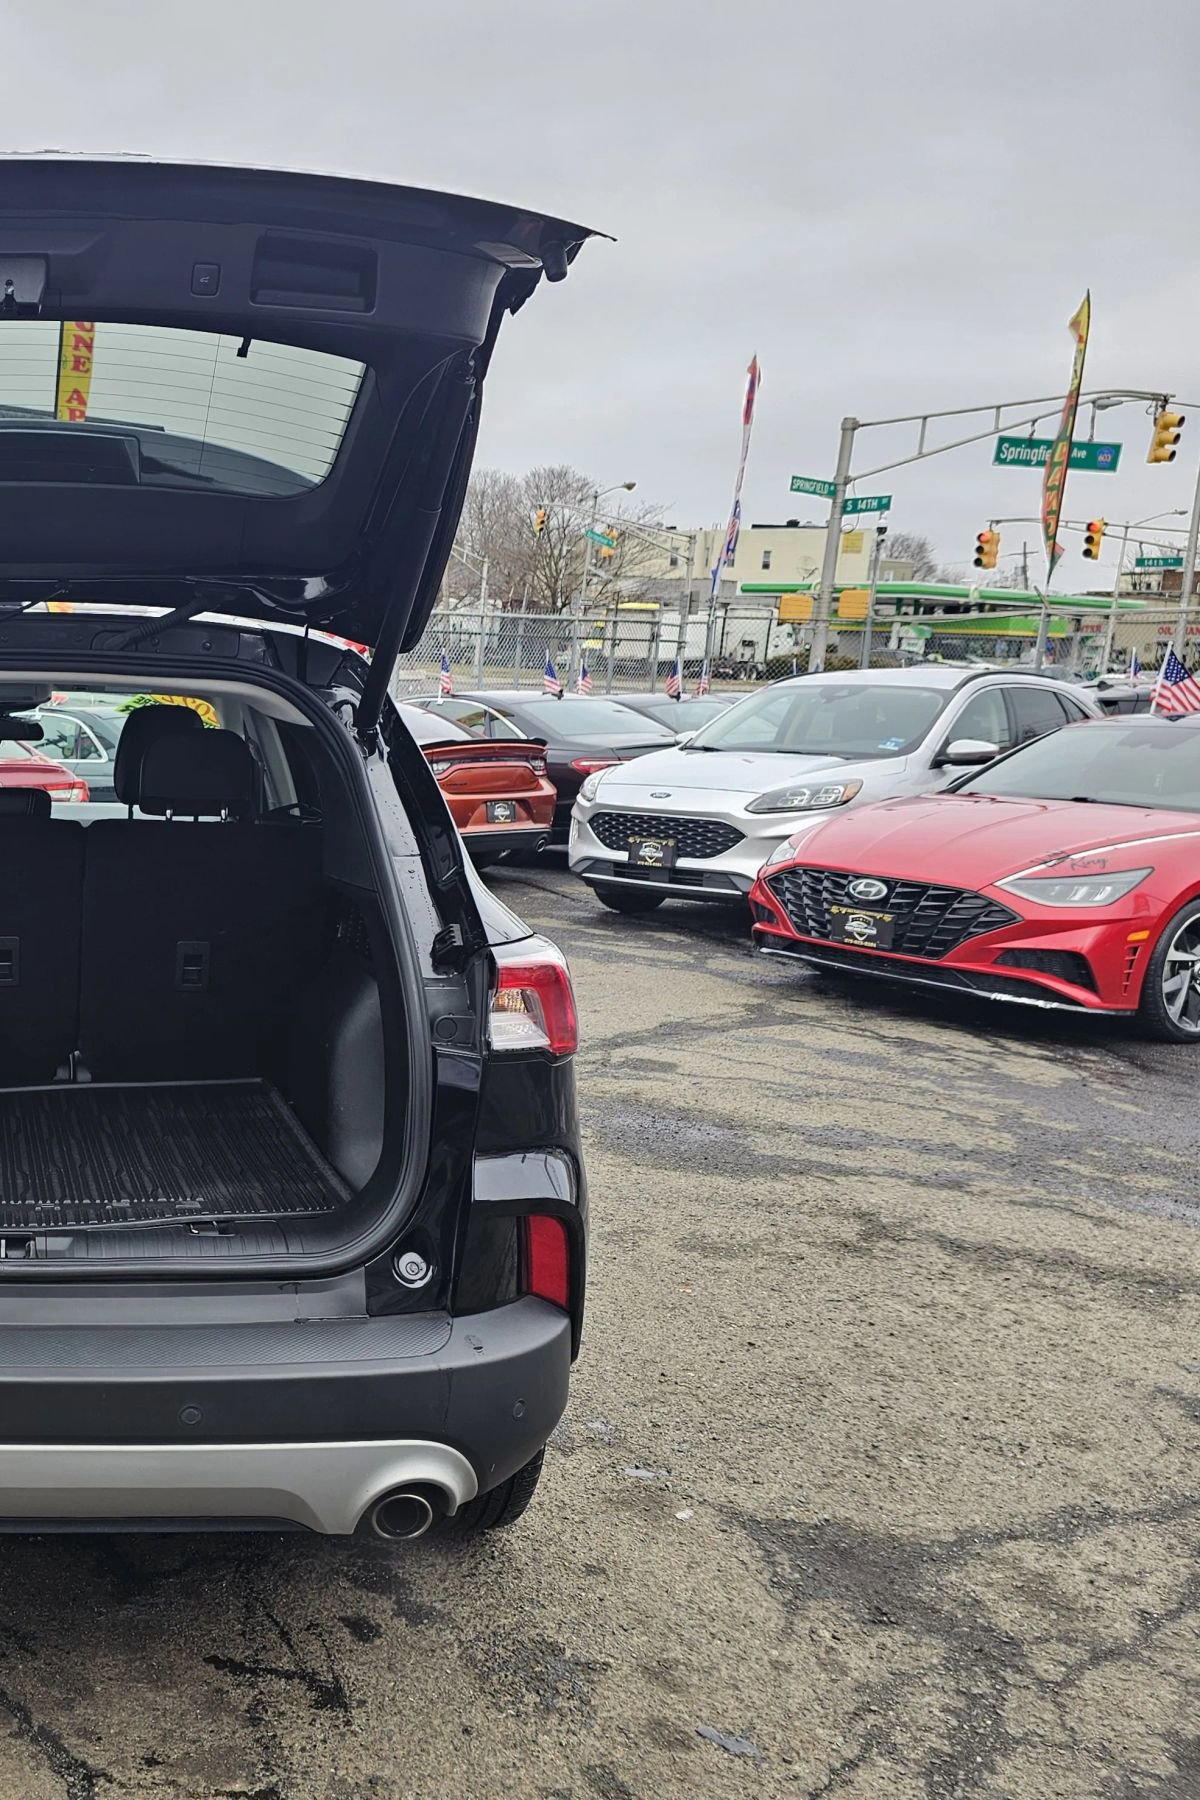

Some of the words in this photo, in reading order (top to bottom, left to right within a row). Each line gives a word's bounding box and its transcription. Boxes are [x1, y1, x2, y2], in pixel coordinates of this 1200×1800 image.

[1000, 442, 1052, 465] Springfie
[1071, 447, 1087, 459] Ave
[792, 478, 830, 494] SPRINGFIELD
[846, 501, 853, 512] S
[857, 498, 878, 511] 14TH
